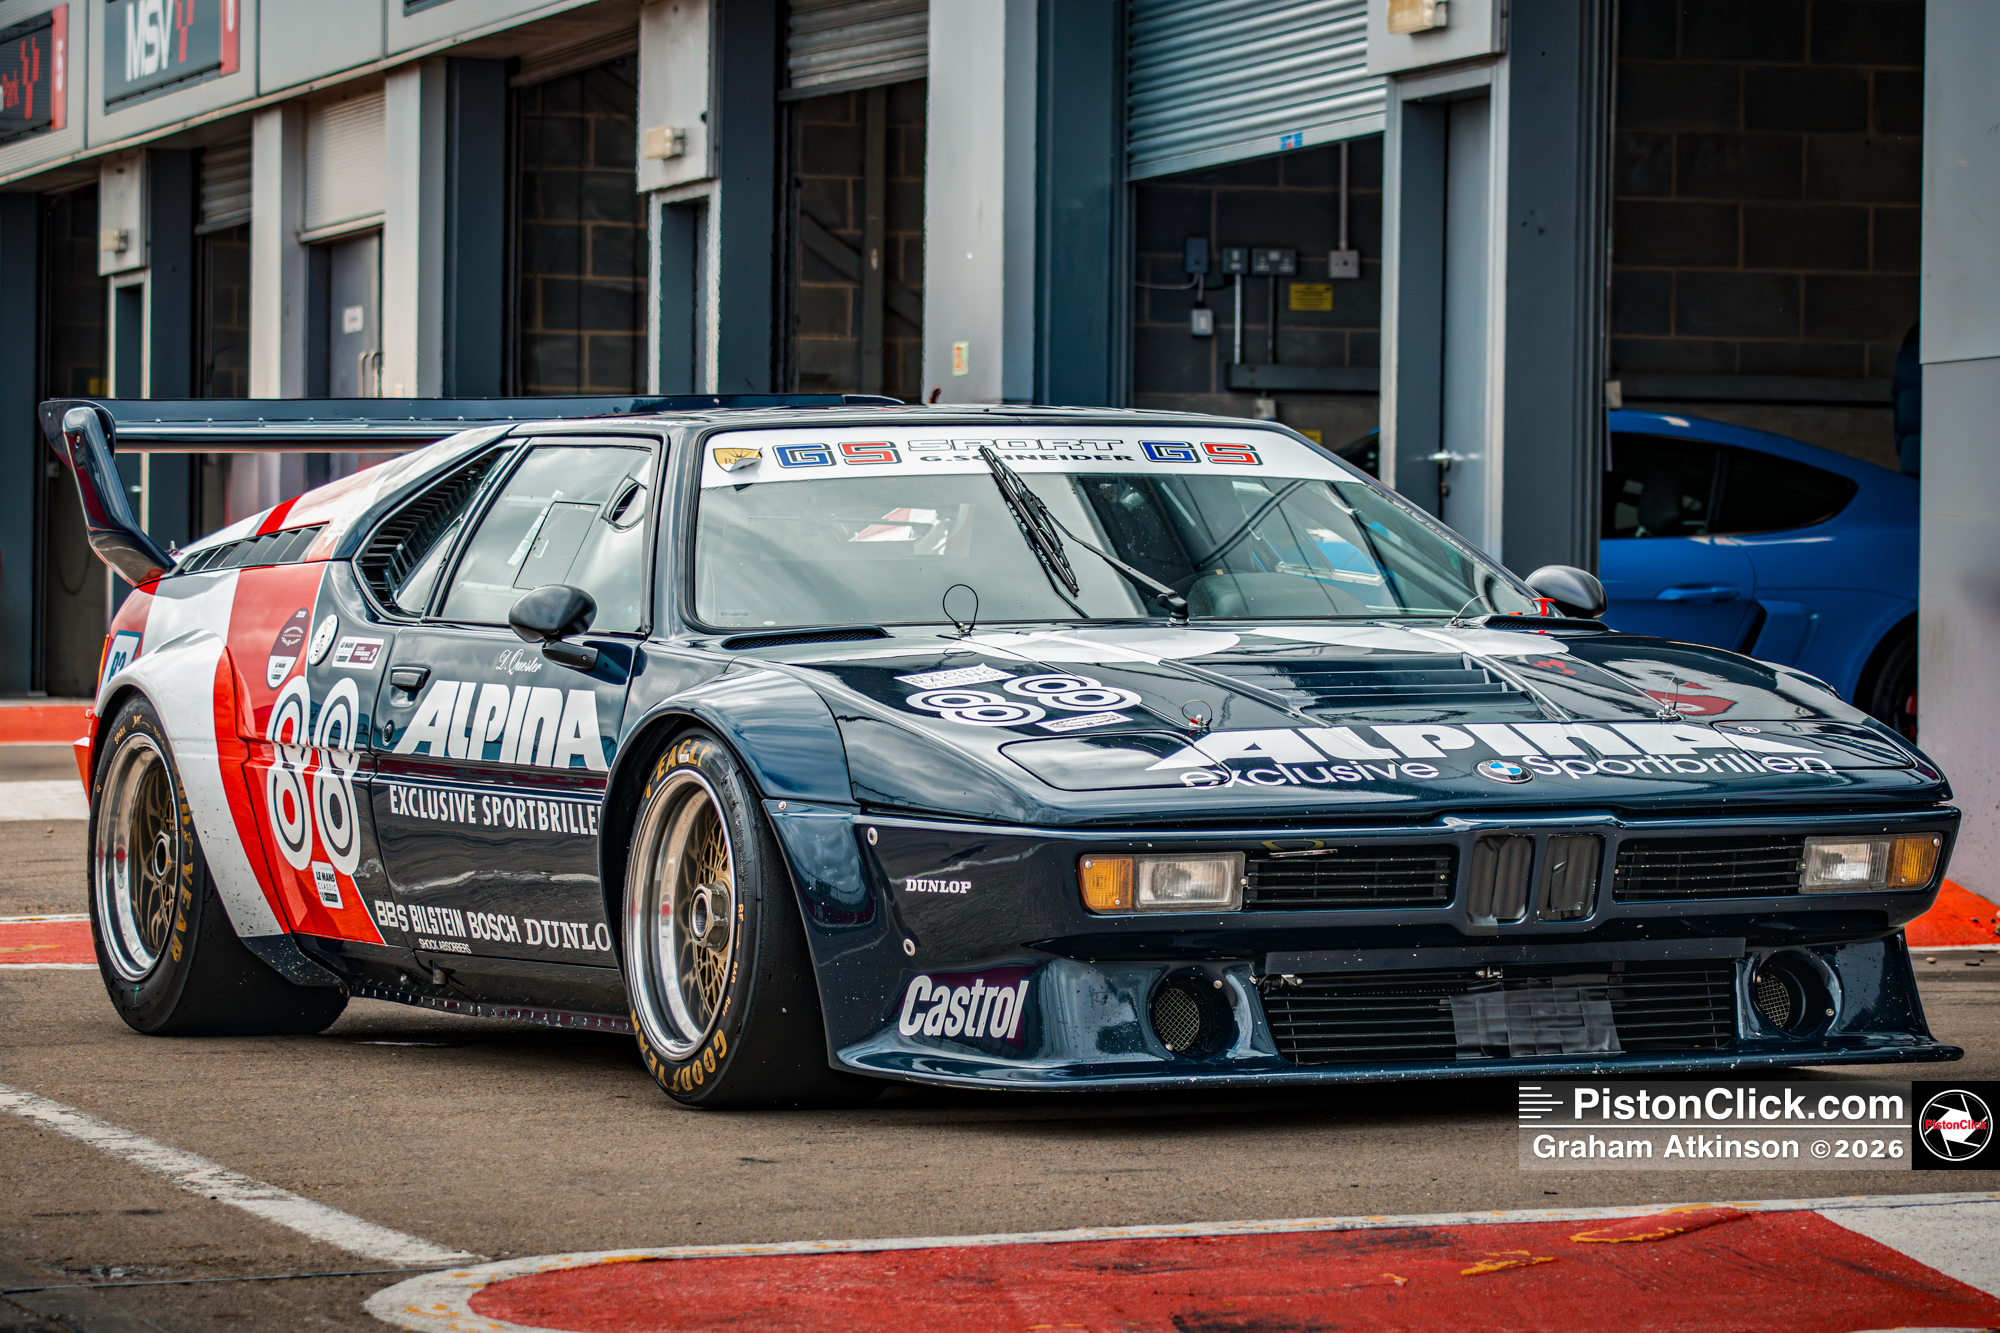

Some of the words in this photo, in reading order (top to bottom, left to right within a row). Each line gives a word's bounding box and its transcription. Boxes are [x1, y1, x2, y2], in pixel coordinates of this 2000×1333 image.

[126, 0, 174, 82] MSV
[907, 438, 1124, 452] SPORT
[905, 673, 1142, 727] 88
[392, 680, 610, 772] ALPINA
[1146, 723, 1824, 771] ALPINA
[265, 675, 361, 876] 88
[1179, 750, 1439, 788] exclusive
[1521, 754, 1837, 780] Sportbrillen
[389, 785, 477, 824] EXCLUSIVE
[482, 796, 601, 836] SPORTBRILLE
[905, 879, 972, 894] DUNLOP
[374, 900, 410, 932] BBS
[408, 904, 467, 938] BILSTEIN
[466, 911, 522, 943] BOSCH
[418, 938, 440, 950] SHOCK
[438, 940, 473, 954] ABSORBERS
[898, 975, 1030, 1039] Castrol
